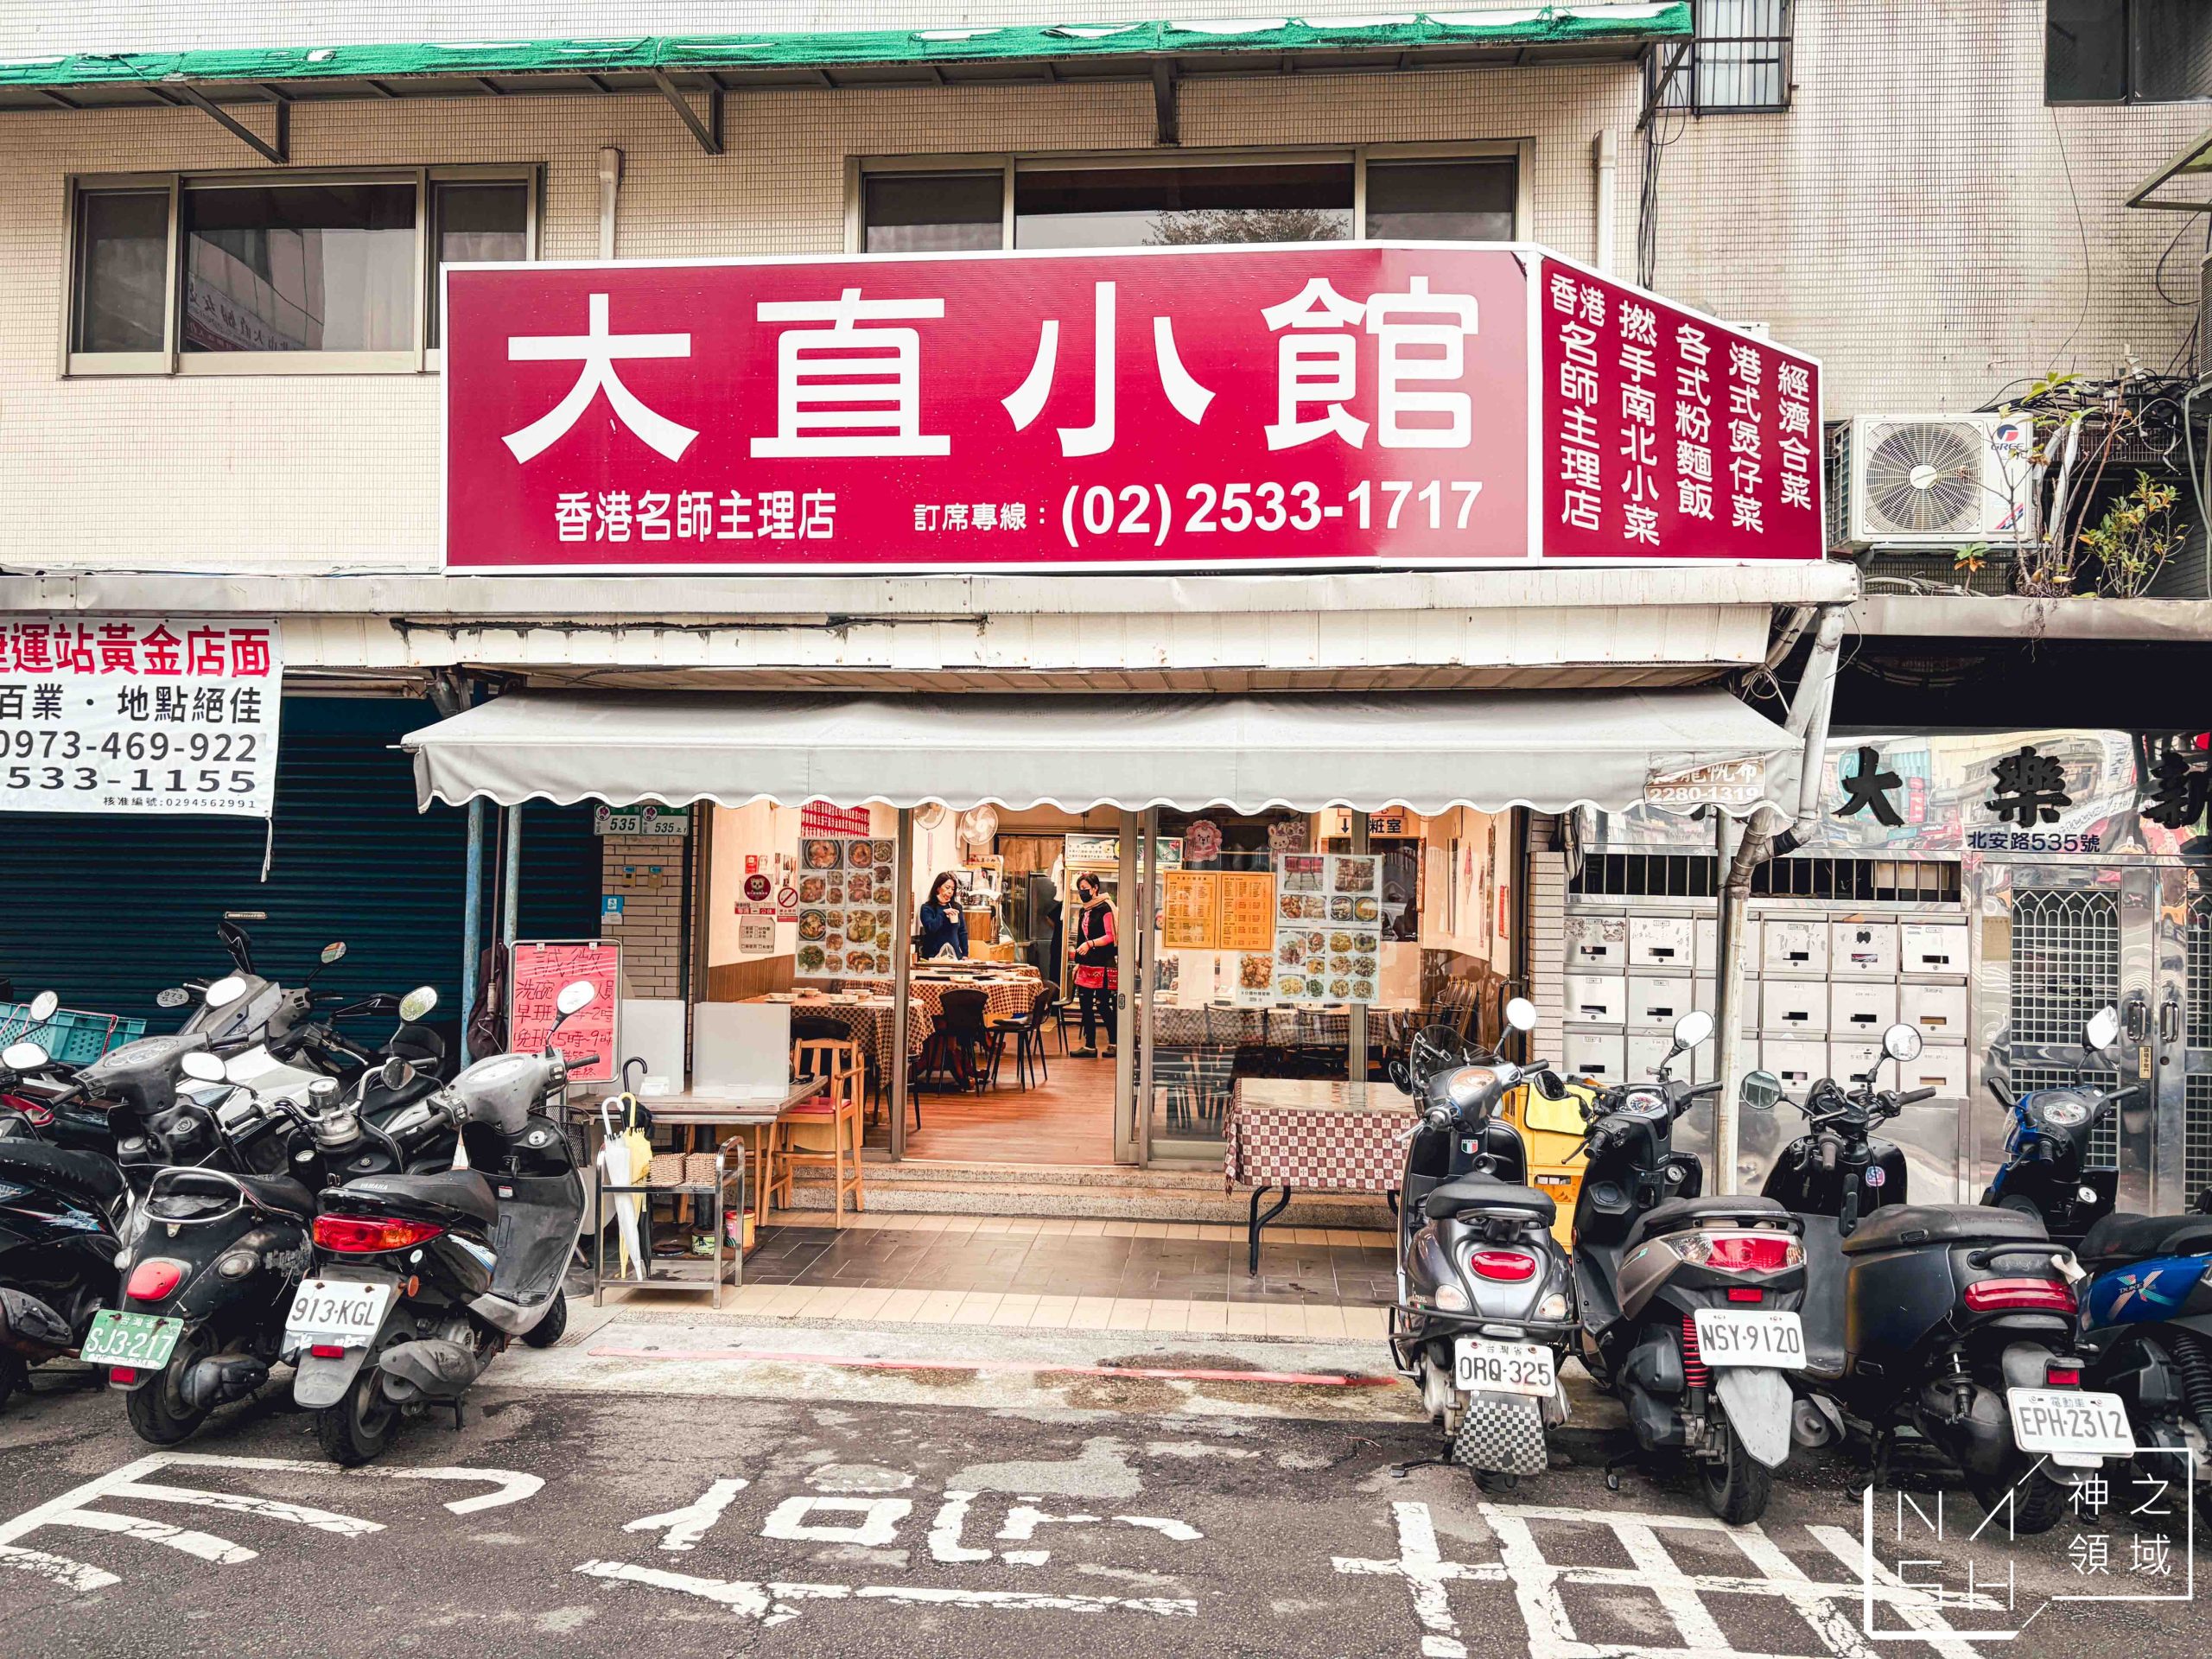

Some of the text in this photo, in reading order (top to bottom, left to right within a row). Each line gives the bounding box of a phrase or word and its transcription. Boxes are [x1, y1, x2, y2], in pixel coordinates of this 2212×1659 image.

[501, 276, 1479, 466] 大直小館
[1618, 300, 1661, 546] 撚手南北小菜
[1675, 323, 1715, 521] 各式粉麵飯
[1728, 341, 1764, 533] 港式煲仔菜
[1777, 361, 1812, 511] 經濟合菜
[554, 488, 836, 543] 香港名師主理店
[1062, 483, 1171, 548] (02)
[1185, 480, 1484, 533] 2533-1717
[0, 623, 270, 678] 運站黃金店面
[609, 817, 636, 831] 535
[1649, 786, 1759, 803] 2280-1319
[1967, 830, 2101, 853] 北安路535號
